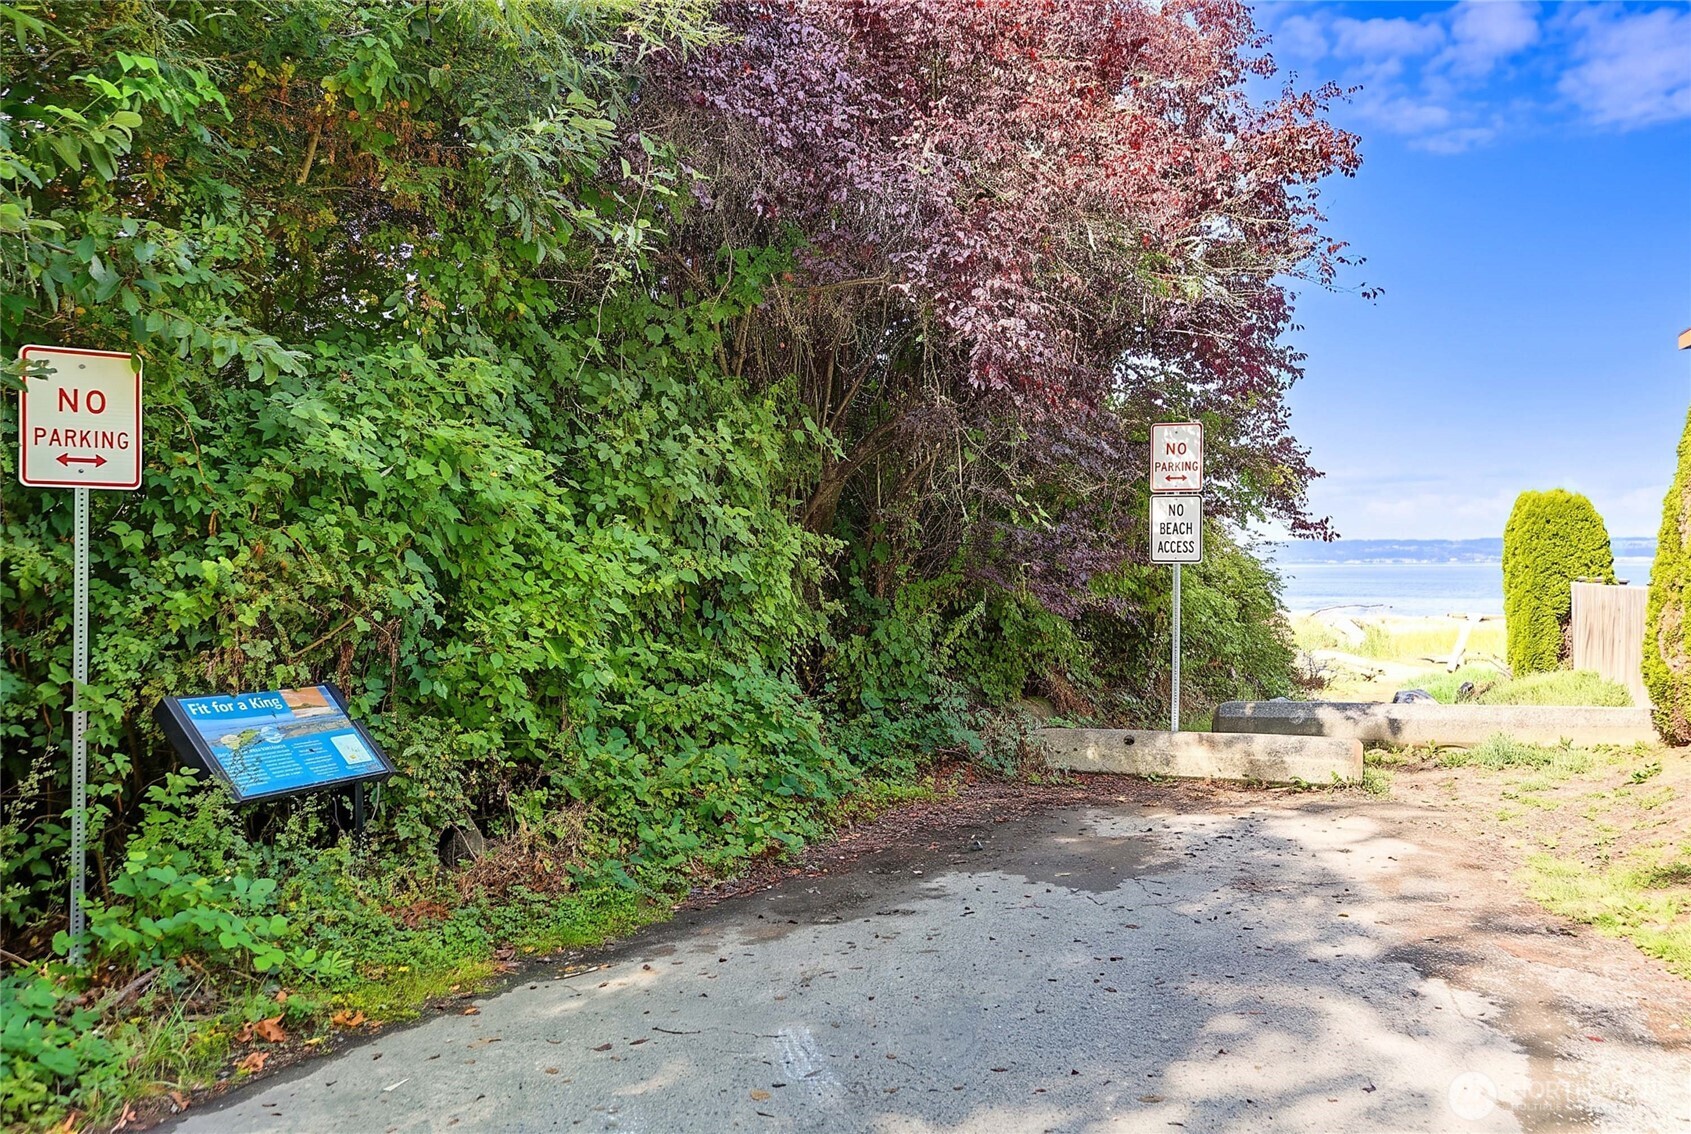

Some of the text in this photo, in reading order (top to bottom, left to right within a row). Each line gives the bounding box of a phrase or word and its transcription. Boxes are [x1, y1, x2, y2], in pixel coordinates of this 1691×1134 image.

[58, 387, 107, 415] NO
[34, 427, 129, 450] PARKING
[1166, 442, 1187, 455] NO
[1154, 461, 1198, 472] PARKING
[1168, 503, 1184, 517] NO
[1159, 522, 1193, 535] BEACH
[1157, 540, 1195, 554] ACCESS
[187, 697, 283, 715] Fit for a King
